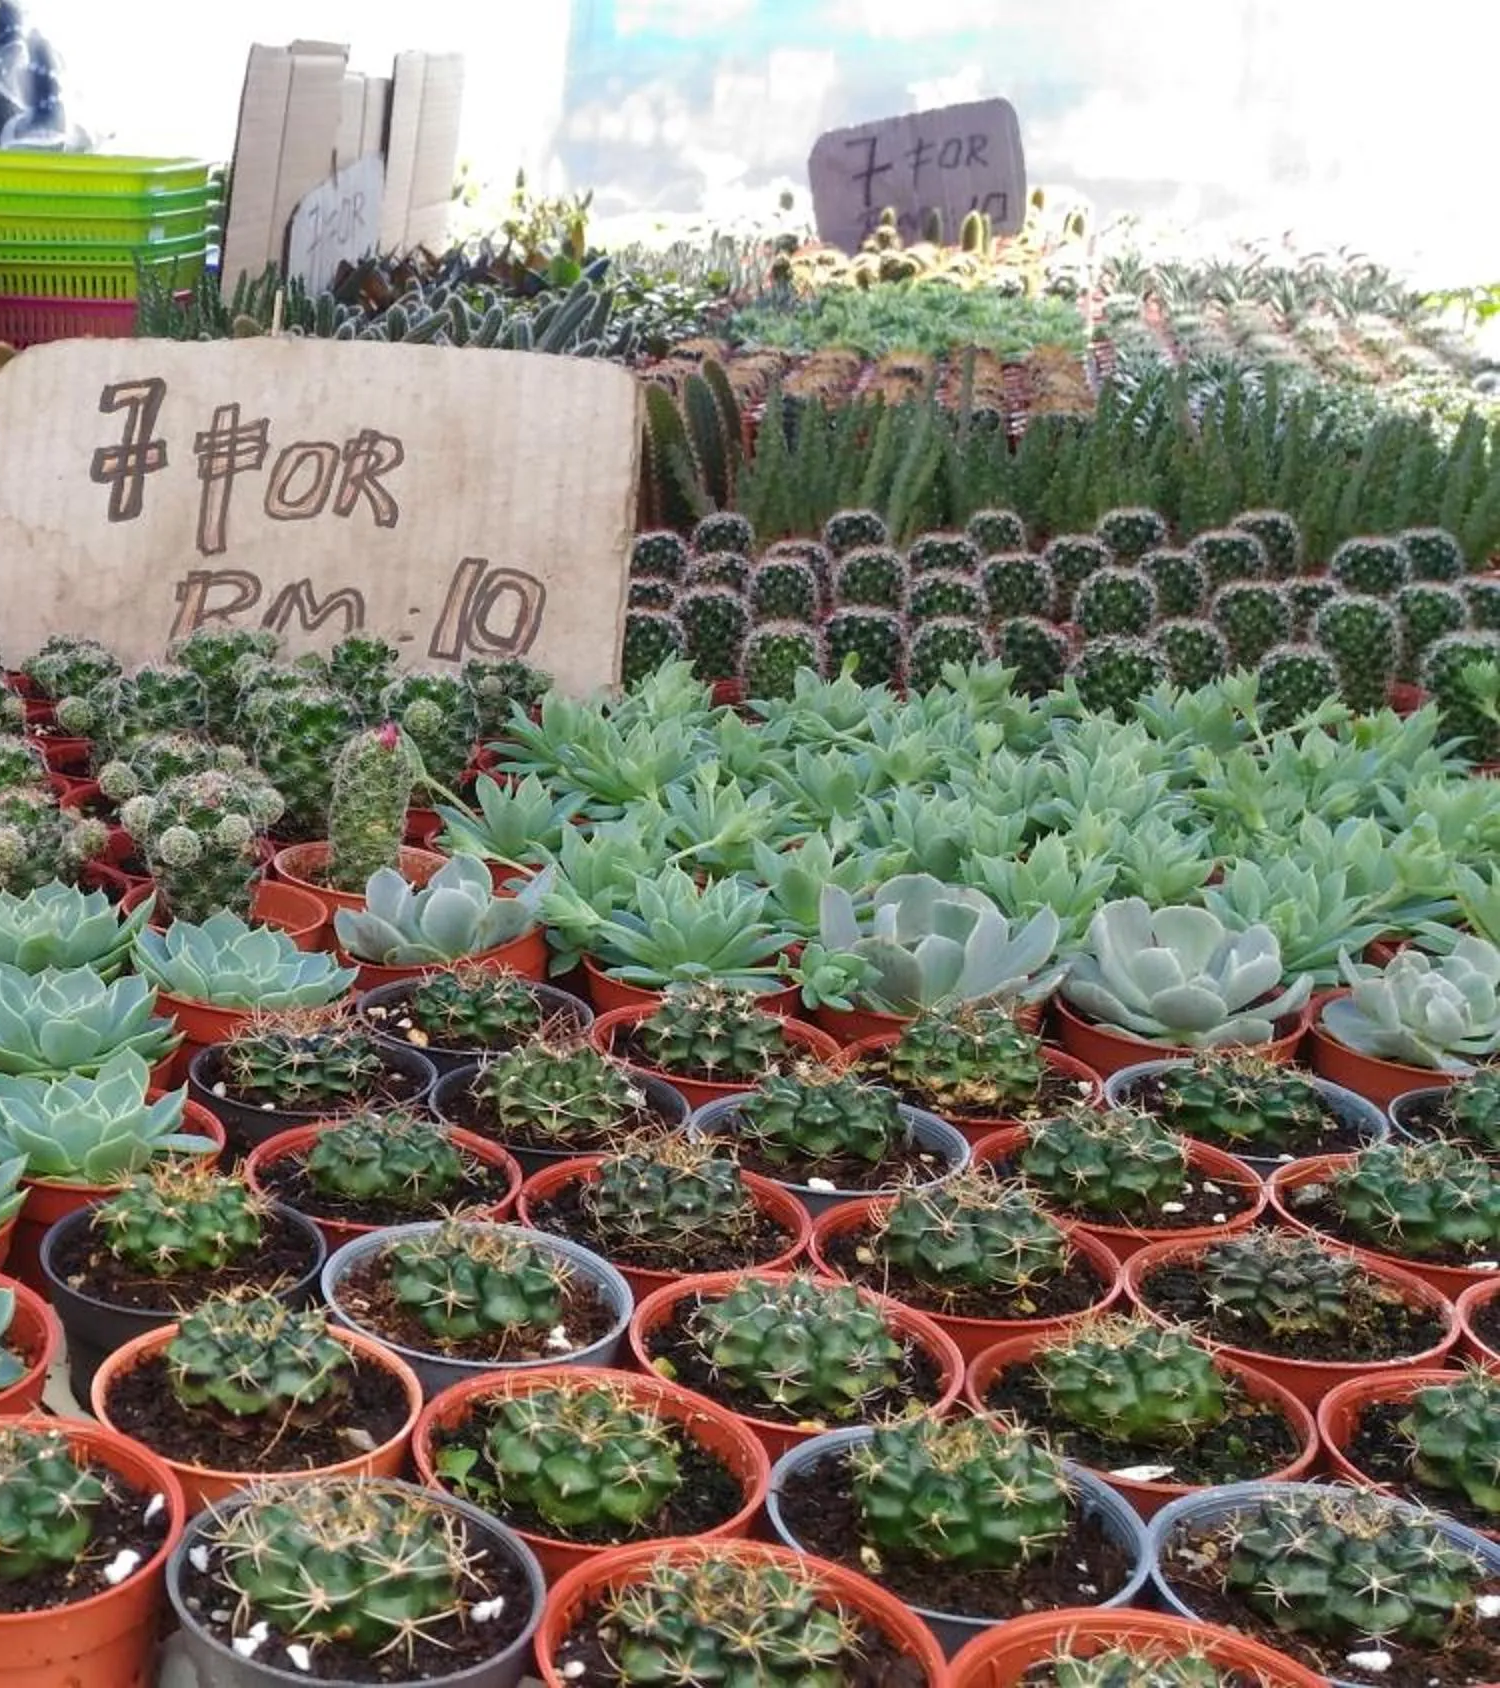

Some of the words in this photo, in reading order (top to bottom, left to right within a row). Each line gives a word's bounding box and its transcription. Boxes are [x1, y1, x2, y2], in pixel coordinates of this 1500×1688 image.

[844, 136, 893, 207] 7
[903, 133, 989, 191] FOR
[90, 377, 168, 523] 7
[194, 402, 404, 556] FOR
